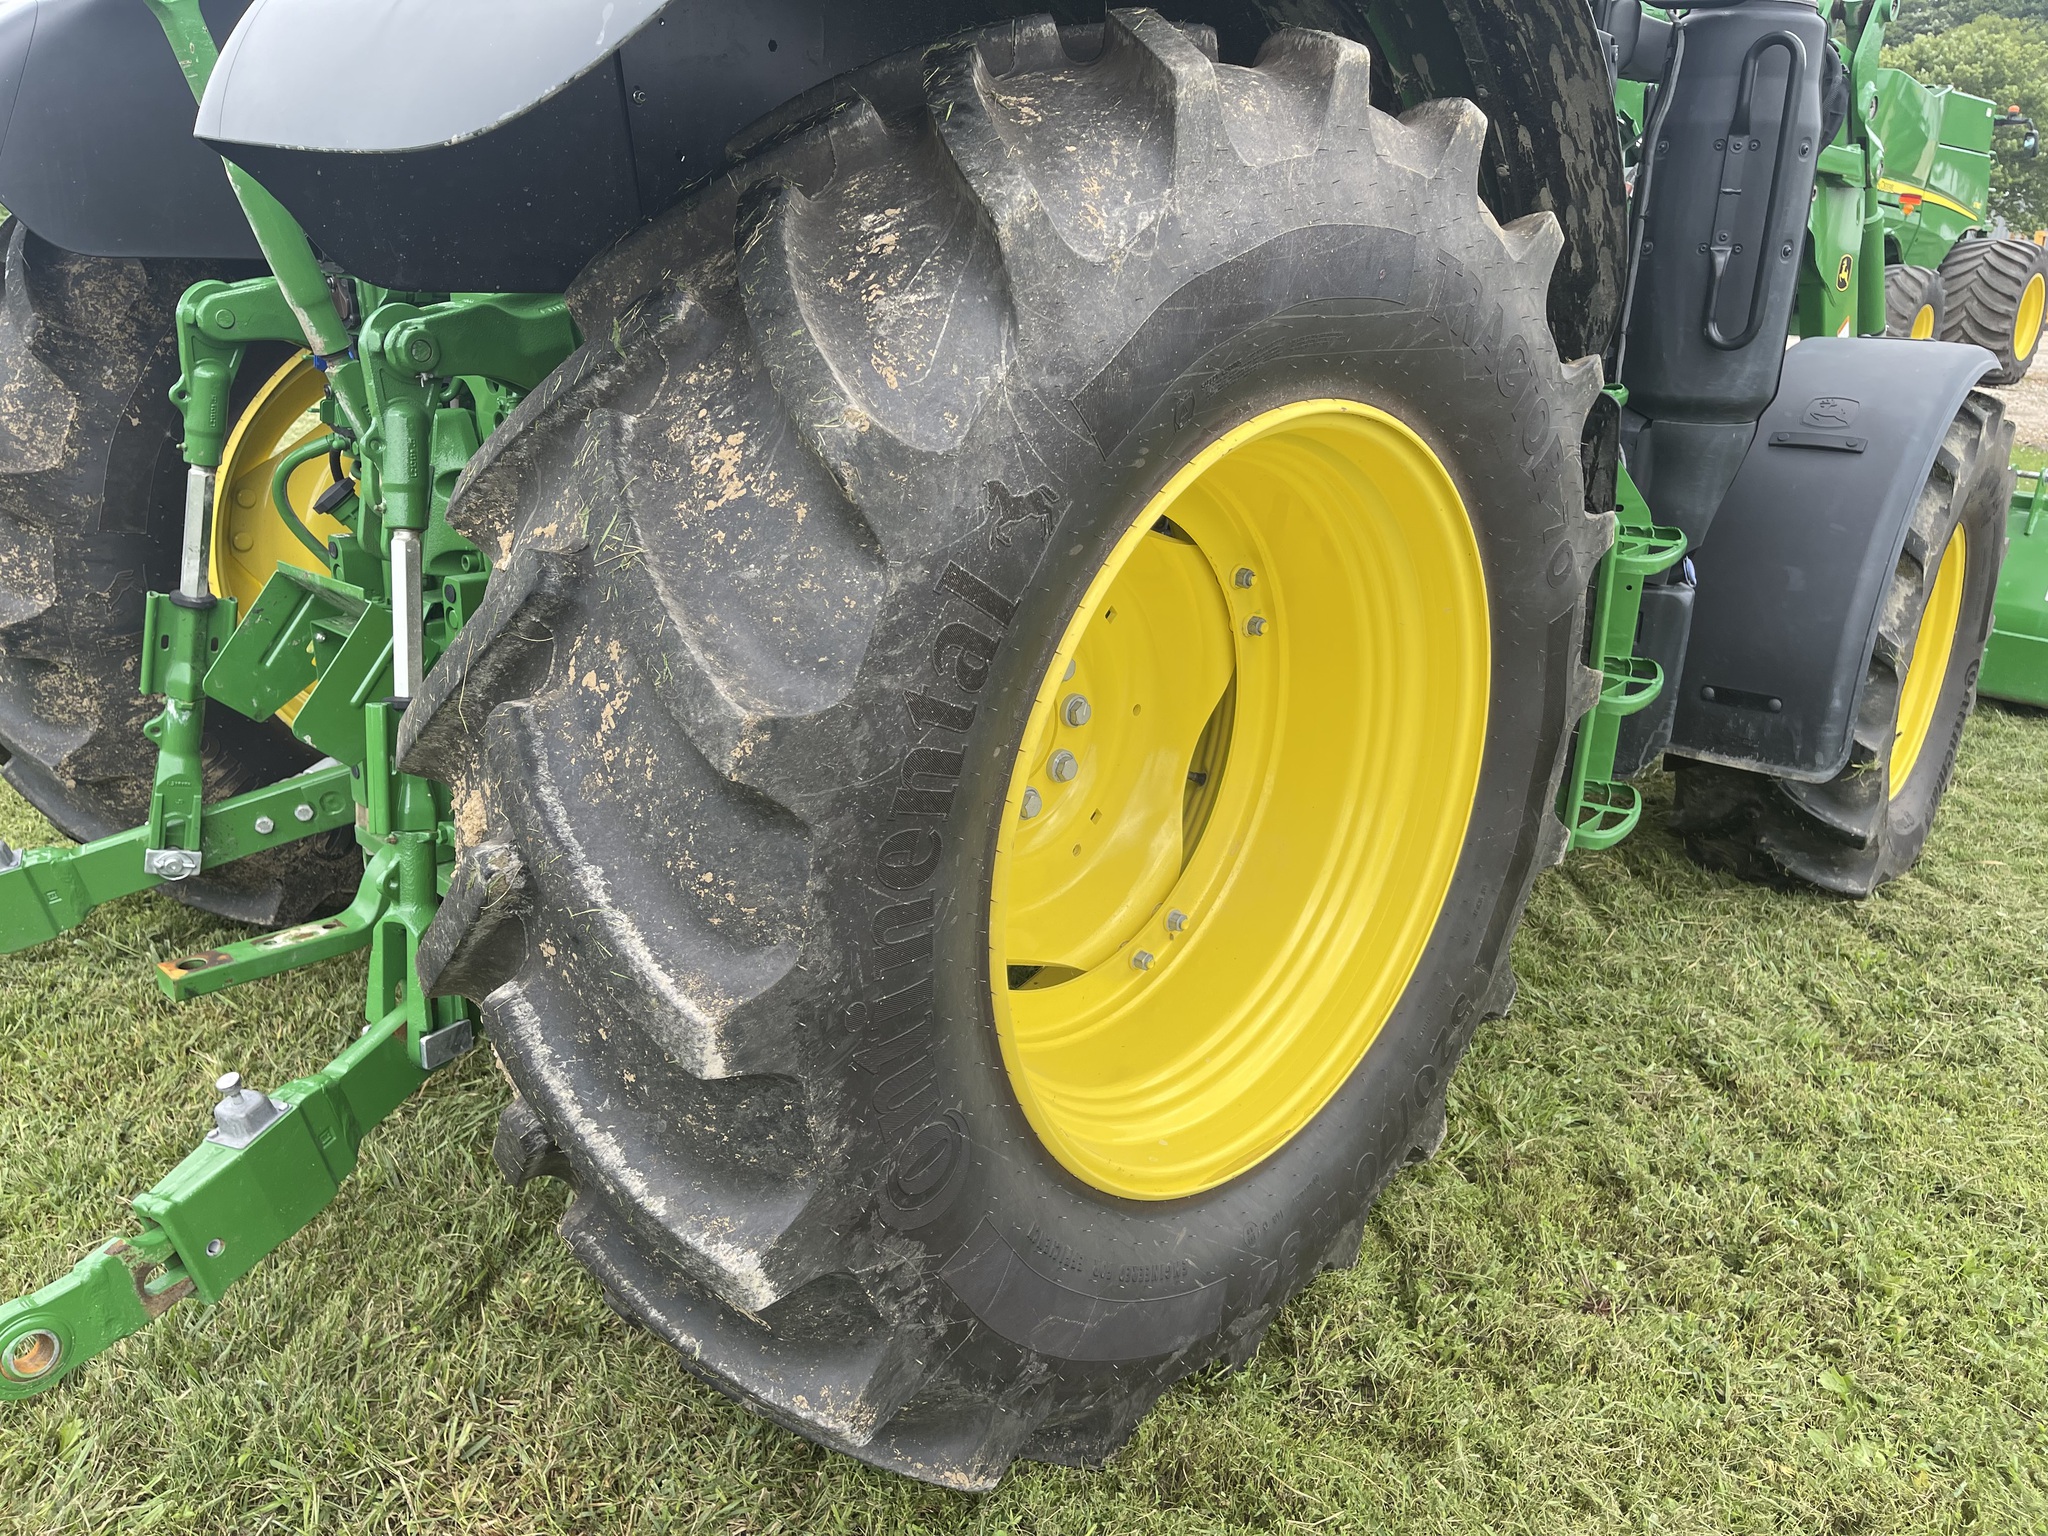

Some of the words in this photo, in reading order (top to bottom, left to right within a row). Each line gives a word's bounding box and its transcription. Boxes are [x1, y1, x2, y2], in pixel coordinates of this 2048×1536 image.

[1430, 247, 1567, 503] TRACTOR
[1541, 499, 1575, 590] 70
[846, 560, 1022, 1231] Continental
[1354, 991, 1477, 1199] 520/70
[1312, 1190, 1344, 1246] R
[1025, 1221, 1085, 1273] EFFICIENCY
[1090, 1261, 1115, 1281] FOR
[1117, 1257, 1188, 1285] ENGINEERED
